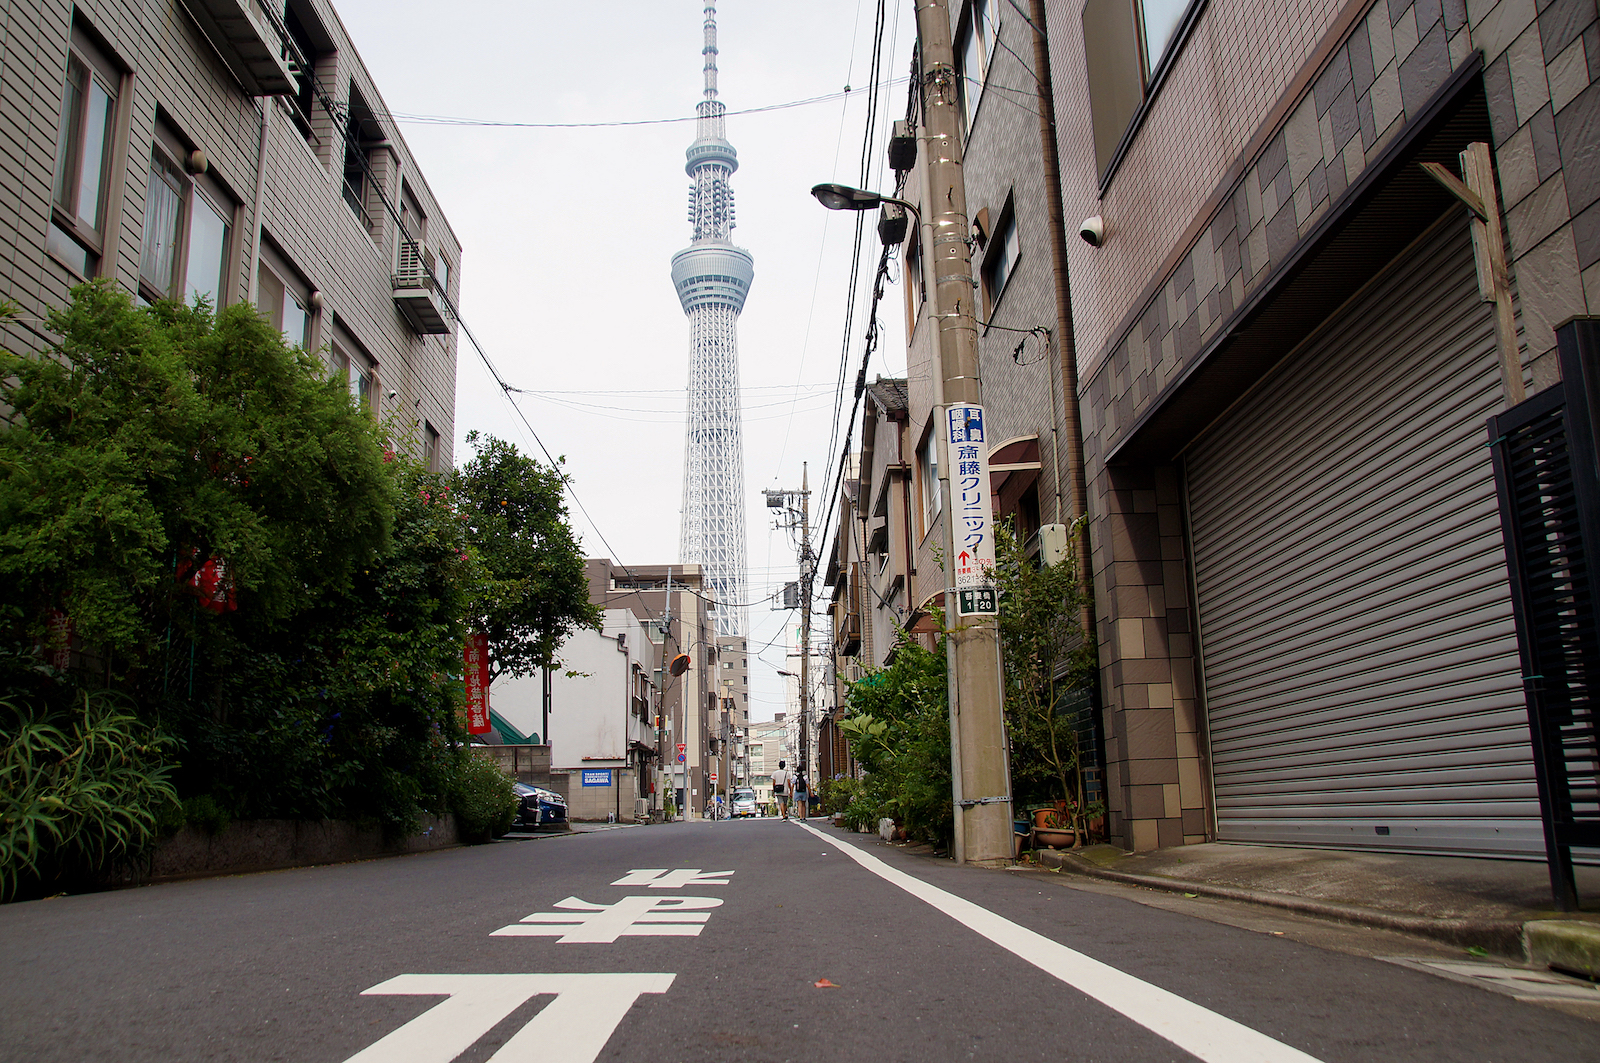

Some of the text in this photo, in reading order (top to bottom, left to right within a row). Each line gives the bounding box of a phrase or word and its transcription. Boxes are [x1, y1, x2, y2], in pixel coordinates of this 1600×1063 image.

[968, 408, 983, 442] 耳鼻
[971, 558, 993, 566] この先
[967, 601, 992, 610] 1-20
